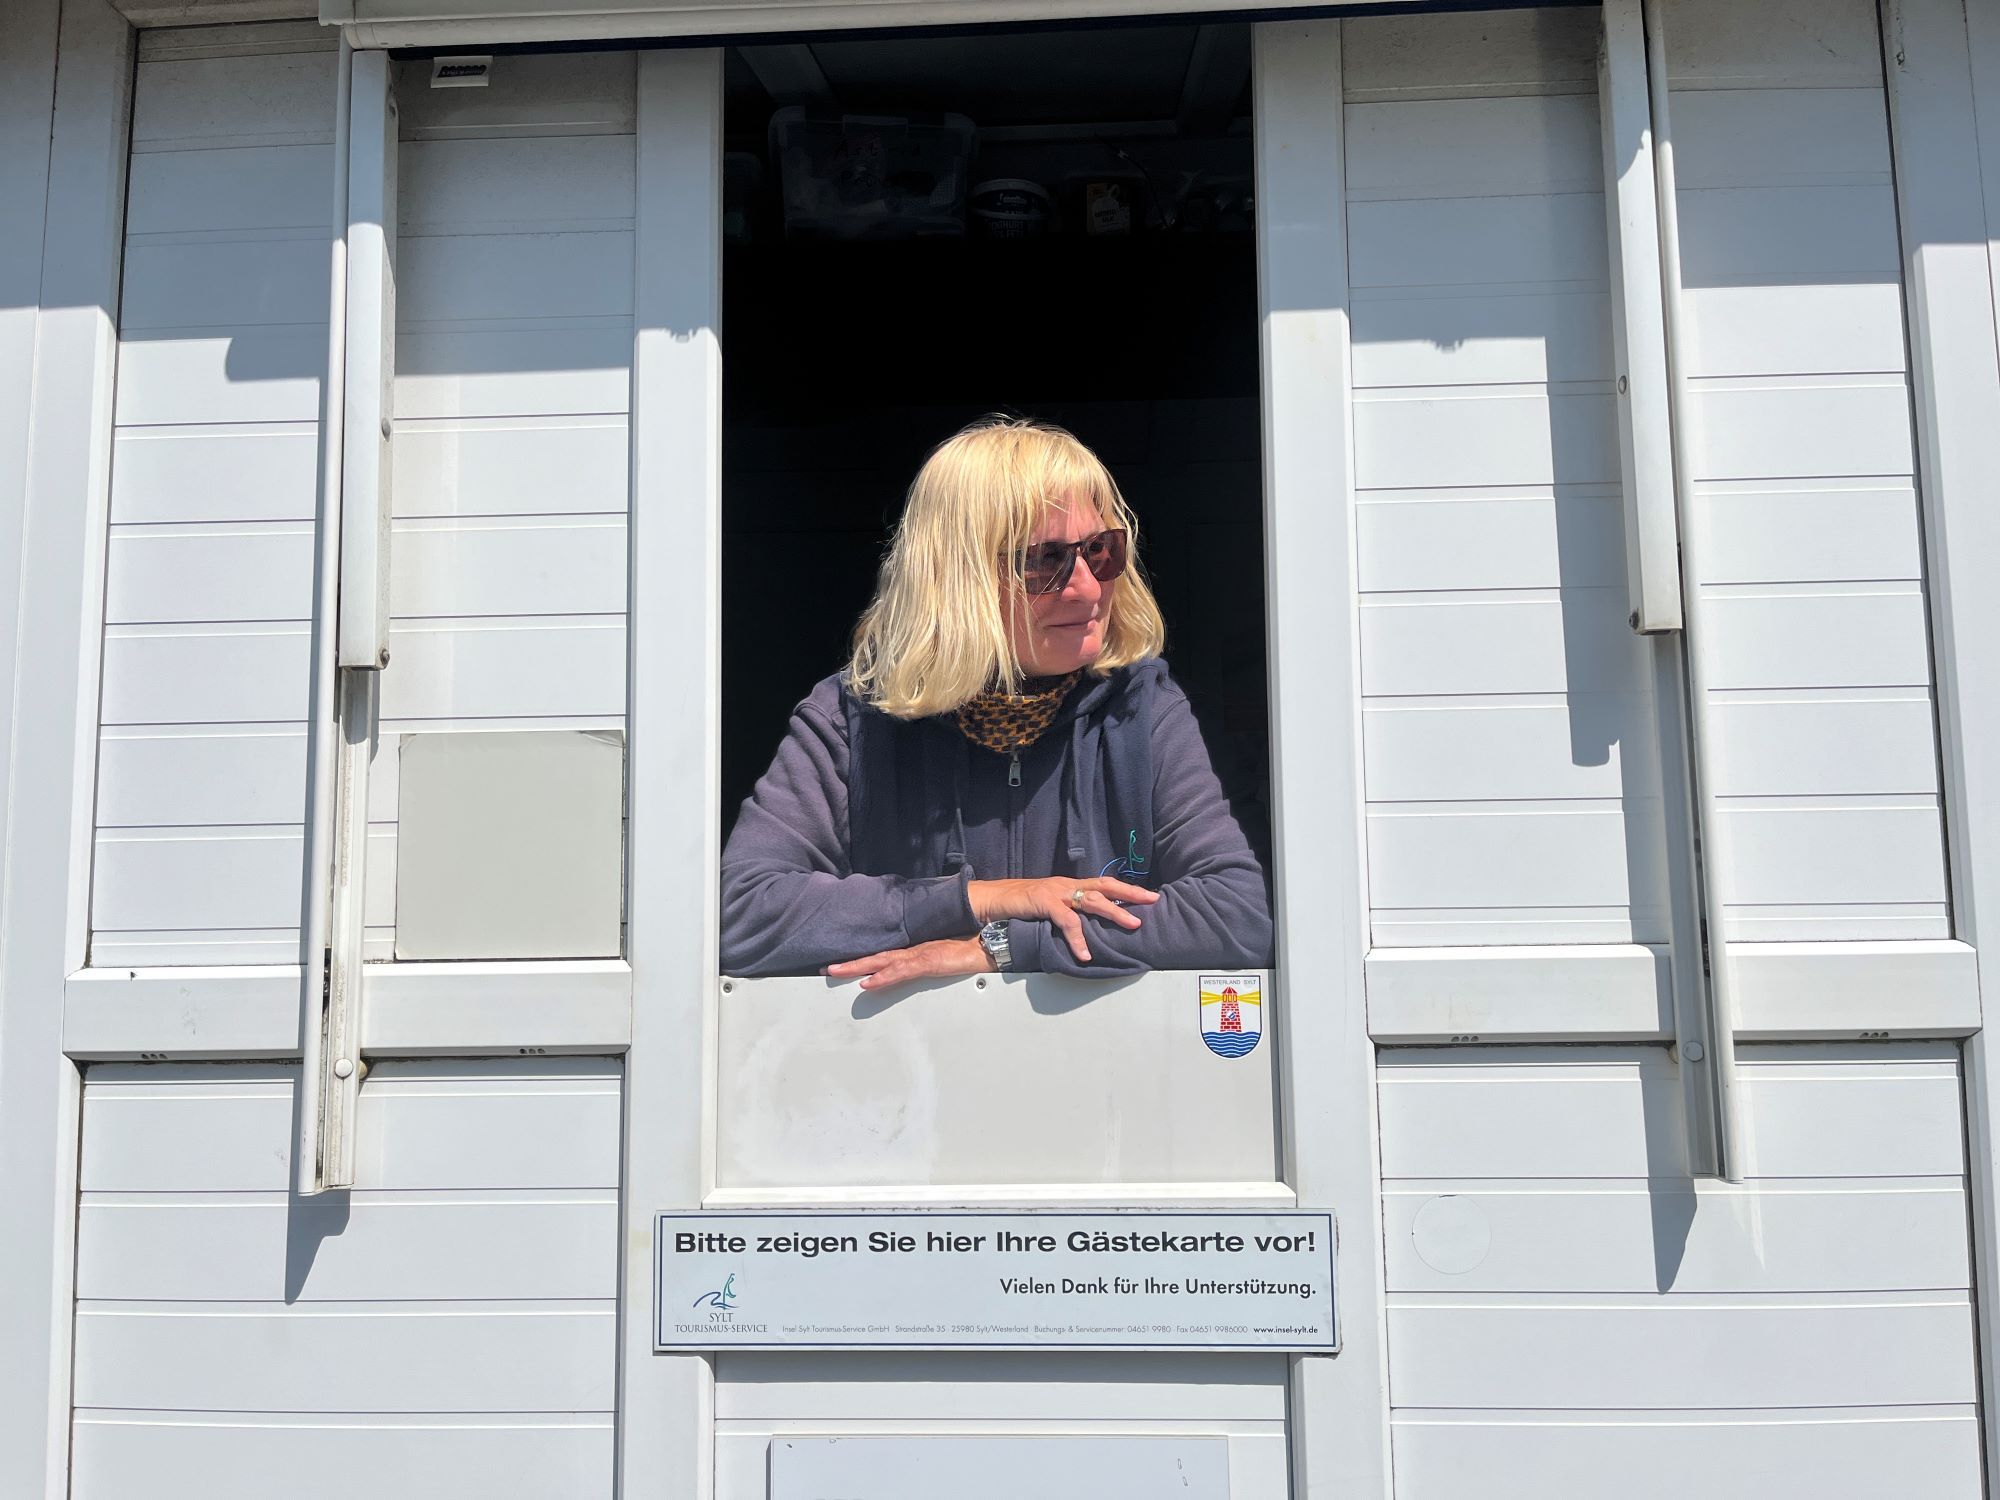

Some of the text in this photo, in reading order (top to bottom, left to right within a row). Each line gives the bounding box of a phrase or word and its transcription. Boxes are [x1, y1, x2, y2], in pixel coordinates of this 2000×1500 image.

[675, 1230, 1315, 1258] Bitte zeigen Sie hier Ihre Gästekarte vor!
[999, 1276, 1317, 1300] Vielen Dank für Ihre Unterstützung.
[708, 1312, 735, 1323] SYLT
[674, 1323, 768, 1333] TOURISMUS-SERVICE
[782, 1325, 797, 1334] Insel
[867, 1325, 890, 1334] GmbH
[895, 1325, 935, 1334] Strandstraße
[936, 1325, 946, 1334] 35
[951, 1325, 975, 1334] 25980
[976, 1325, 1029, 1335] Sylt/Westerland
[1067, 1325, 1075, 1334] &
[1127, 1325, 1150, 1334] 04651
[1151, 1325, 1172, 1334] 9980
[1189, 1325, 1212, 1334] 04651
[1214, 1325, 1249, 1334] 9986000
[1253, 1325, 1319, 1336] www.insel-sylt.de
